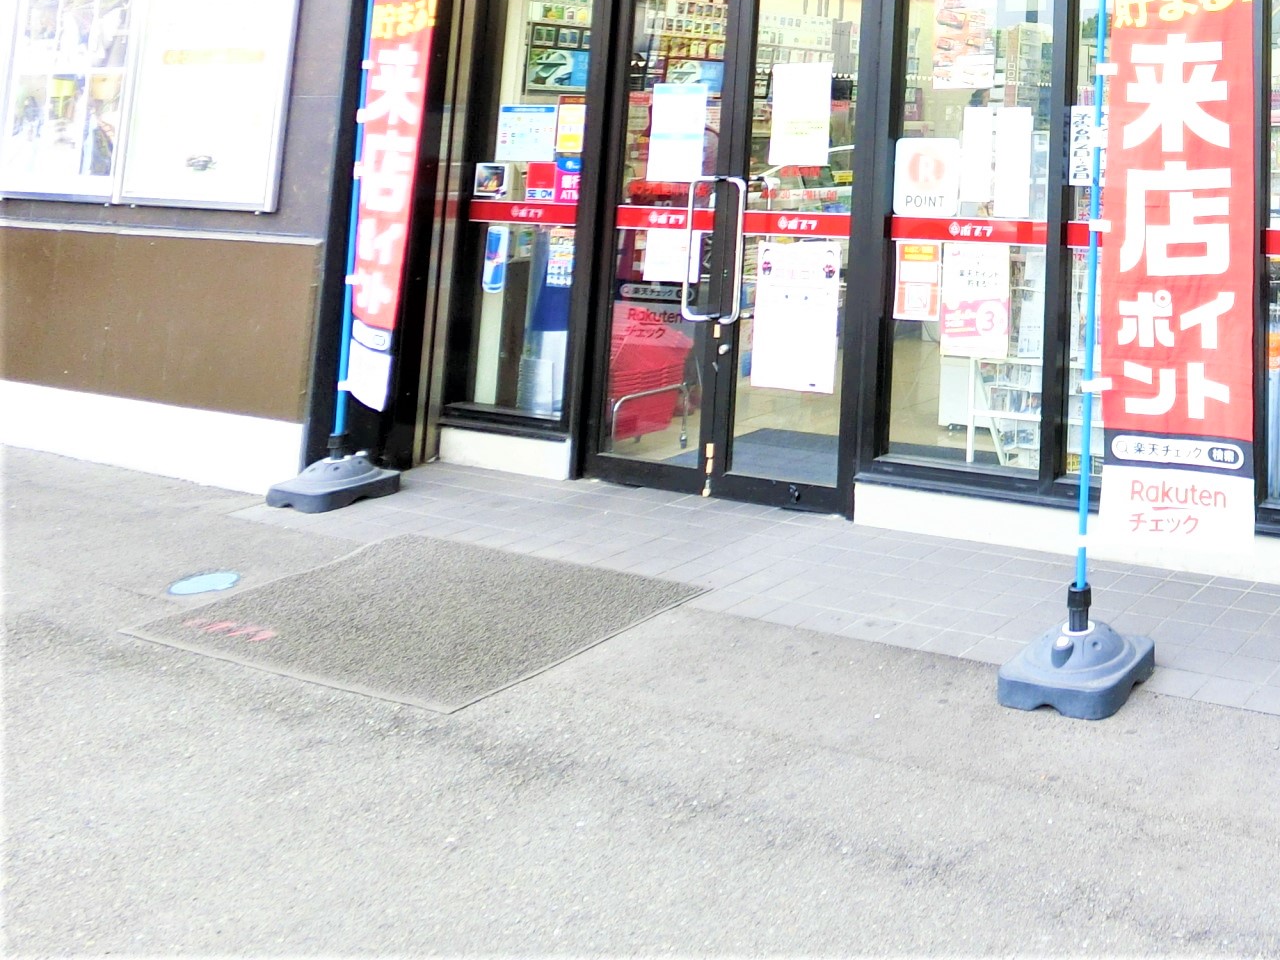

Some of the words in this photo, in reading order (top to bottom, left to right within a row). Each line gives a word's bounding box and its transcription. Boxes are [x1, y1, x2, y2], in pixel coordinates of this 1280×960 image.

[1119, 33, 1233, 277] 来店
[527, 189, 553, 198] SEOM
[905, 195, 945, 208] POINT
[787, 217, 818, 230] ポプラ
[960, 223, 994, 237] ポプラ
[631, 288, 673, 297] 楽天チェック
[627, 307, 683, 324] Rakuten
[624, 325, 666, 339] チェック
[1134, 442, 1203, 459] 楽天チェック
[1130, 479, 1227, 509] Rakuten
[1128, 512, 1199, 535] チェック
